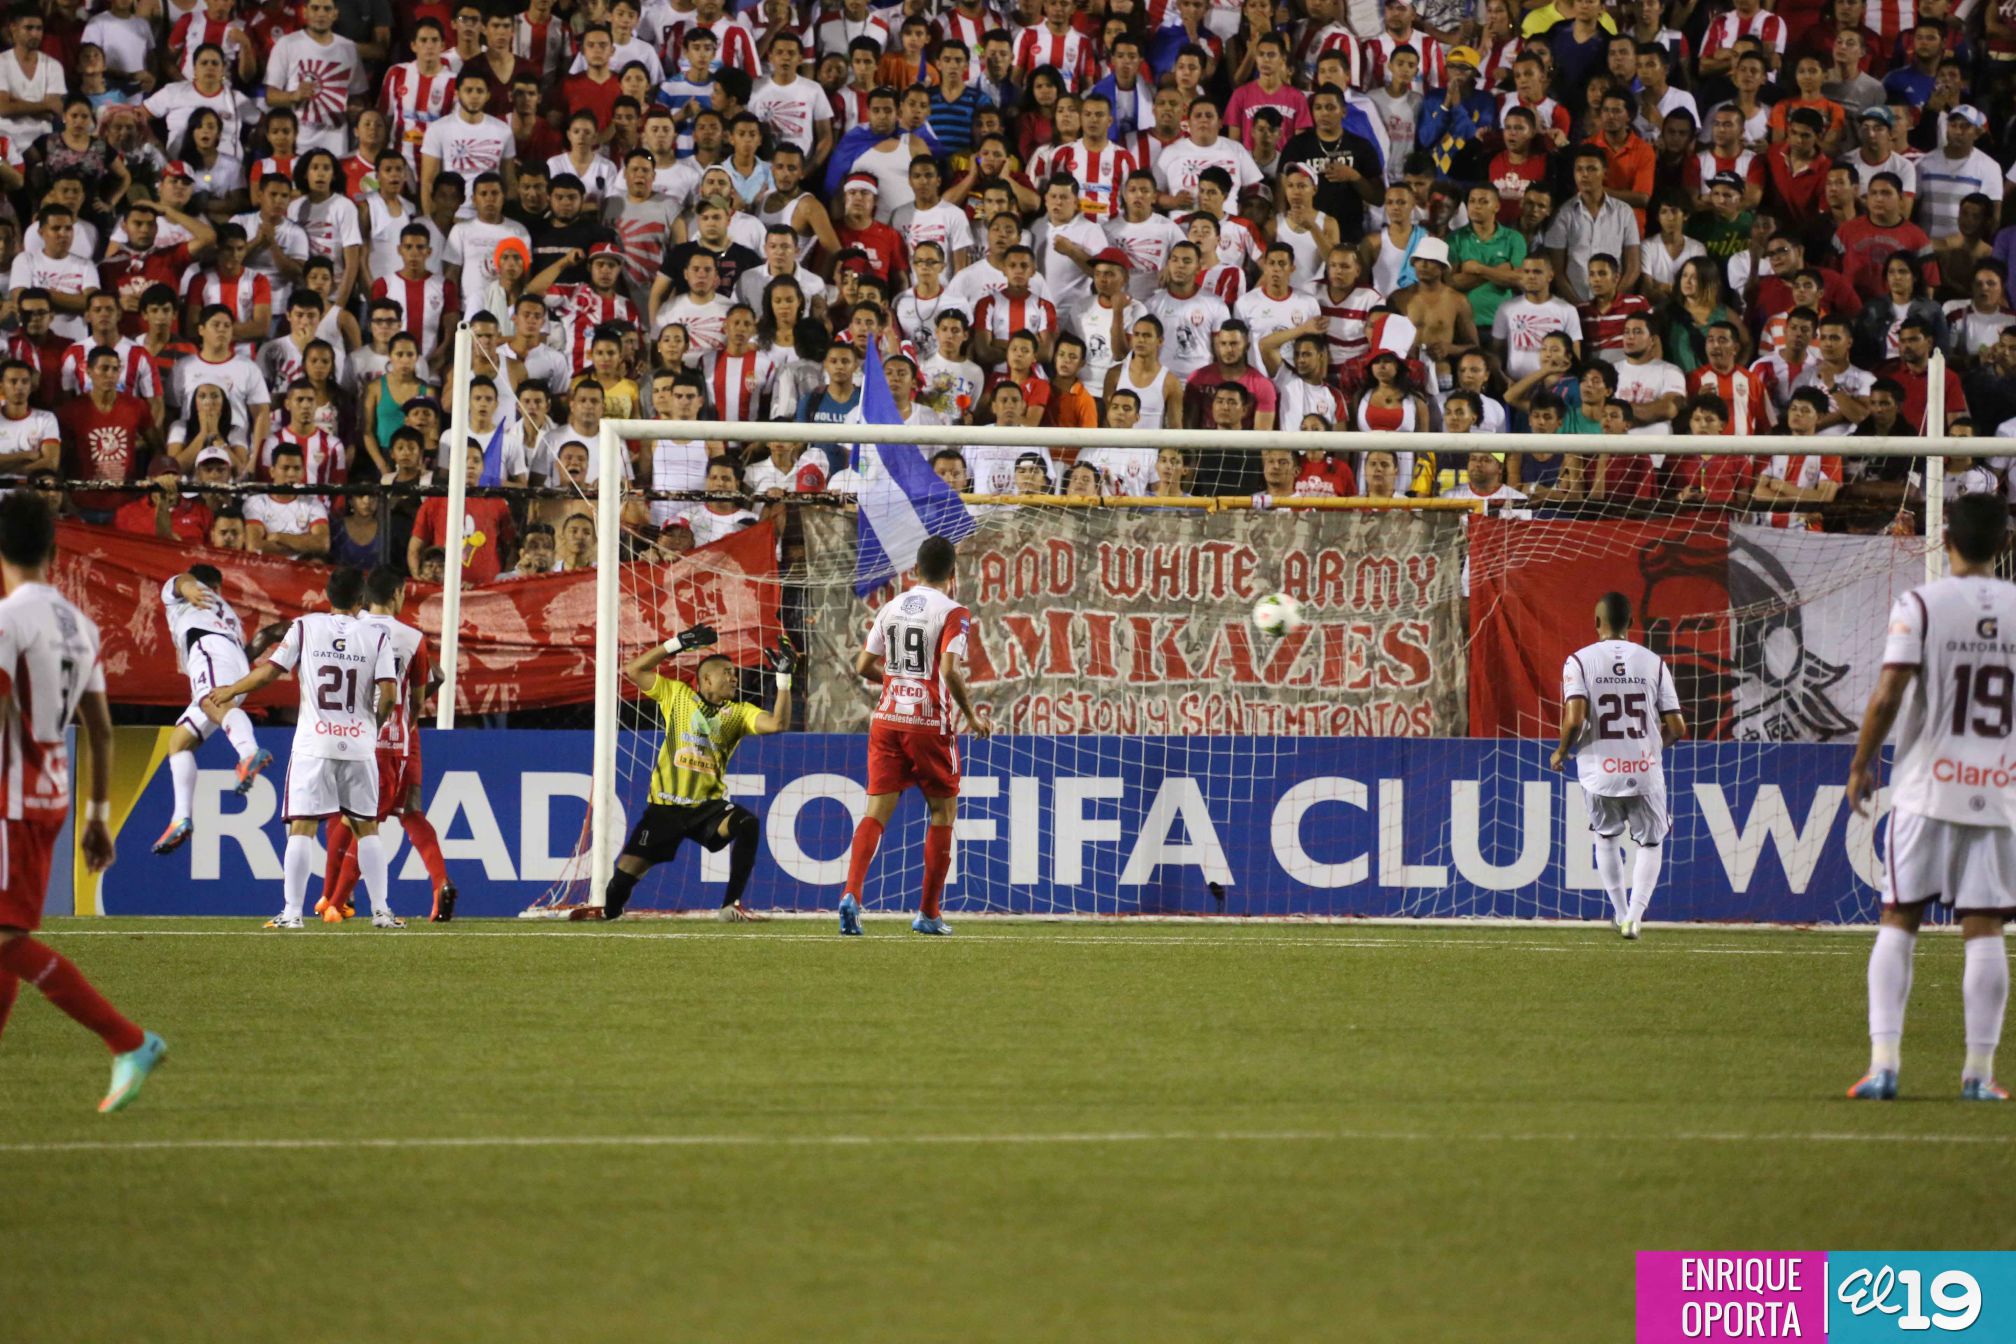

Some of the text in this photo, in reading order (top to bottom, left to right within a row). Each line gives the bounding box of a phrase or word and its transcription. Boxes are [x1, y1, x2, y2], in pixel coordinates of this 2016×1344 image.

[980, 537, 1076, 603] AND
[1099, 540, 1258, 600] WHITE
[1282, 547, 1439, 611] ARMY
[312, 650, 366, 663] GATORADE
[866, 608, 1434, 692] AMIKAZES
[886, 624, 925, 672] 19
[317, 665, 357, 713] 21
[1595, 677, 1647, 685] GATORADE
[1952, 664, 2014, 738] 19
[315, 720, 361, 738] Claro
[1598, 693, 1648, 740] 25
[1603, 757, 1650, 774] Claro
[1933, 757, 2011, 788] Claro
[190, 768, 627, 881] RAD
